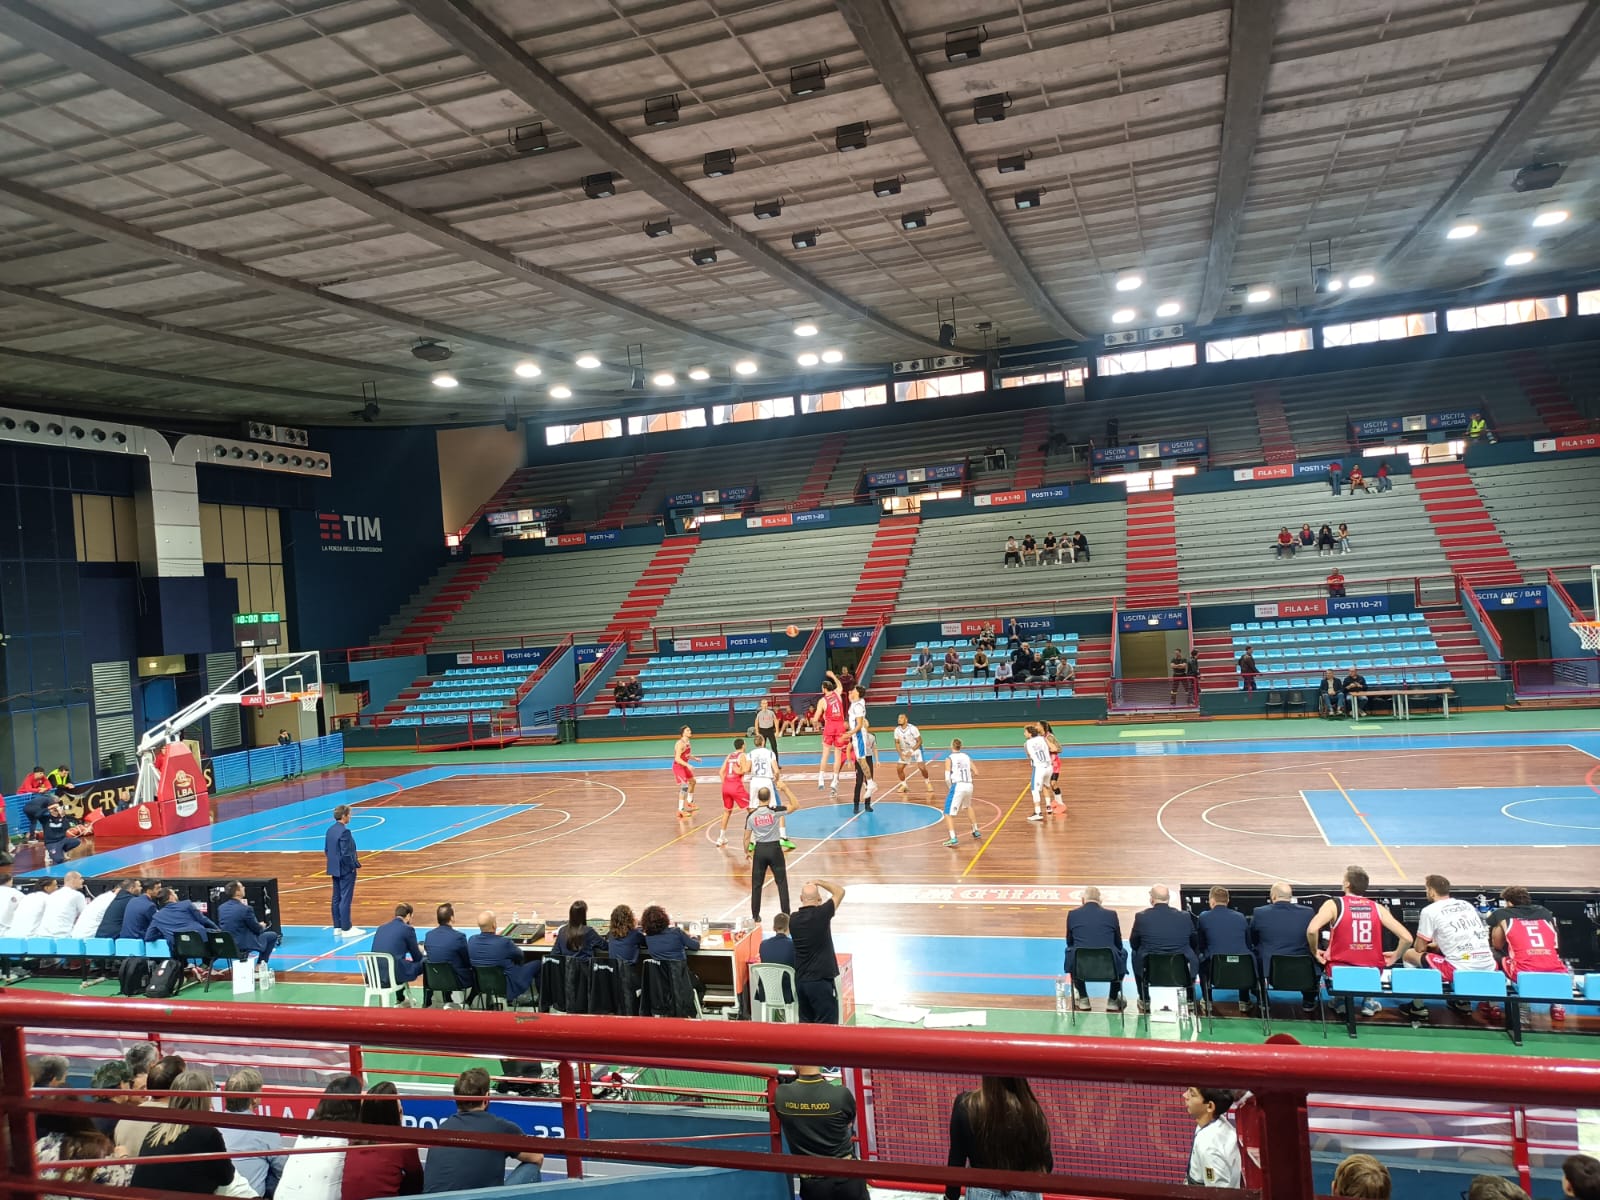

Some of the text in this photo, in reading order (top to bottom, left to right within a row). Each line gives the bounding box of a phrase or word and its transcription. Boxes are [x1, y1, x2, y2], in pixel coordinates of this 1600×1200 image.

[1440, 412, 1466, 420] USCITA
[1171, 441, 1194, 449] USCITA
[1104, 448, 1126, 456] USCITA
[1300, 465, 1320, 473] POSTI
[1031, 489, 1063, 499] POSTI 1-20
[343, 515, 382, 541] TIM
[1285, 605, 1301, 613] FILA
[1334, 600, 1383, 610] POSTI 10-21
[730, 638, 749, 646] POSTI
[755, 762, 767, 776] 25
[960, 769, 969, 783] 11
[176, 787, 193, 798] LBA
[1352, 919, 1372, 943] 18
[1525, 926, 1545, 948] 5
